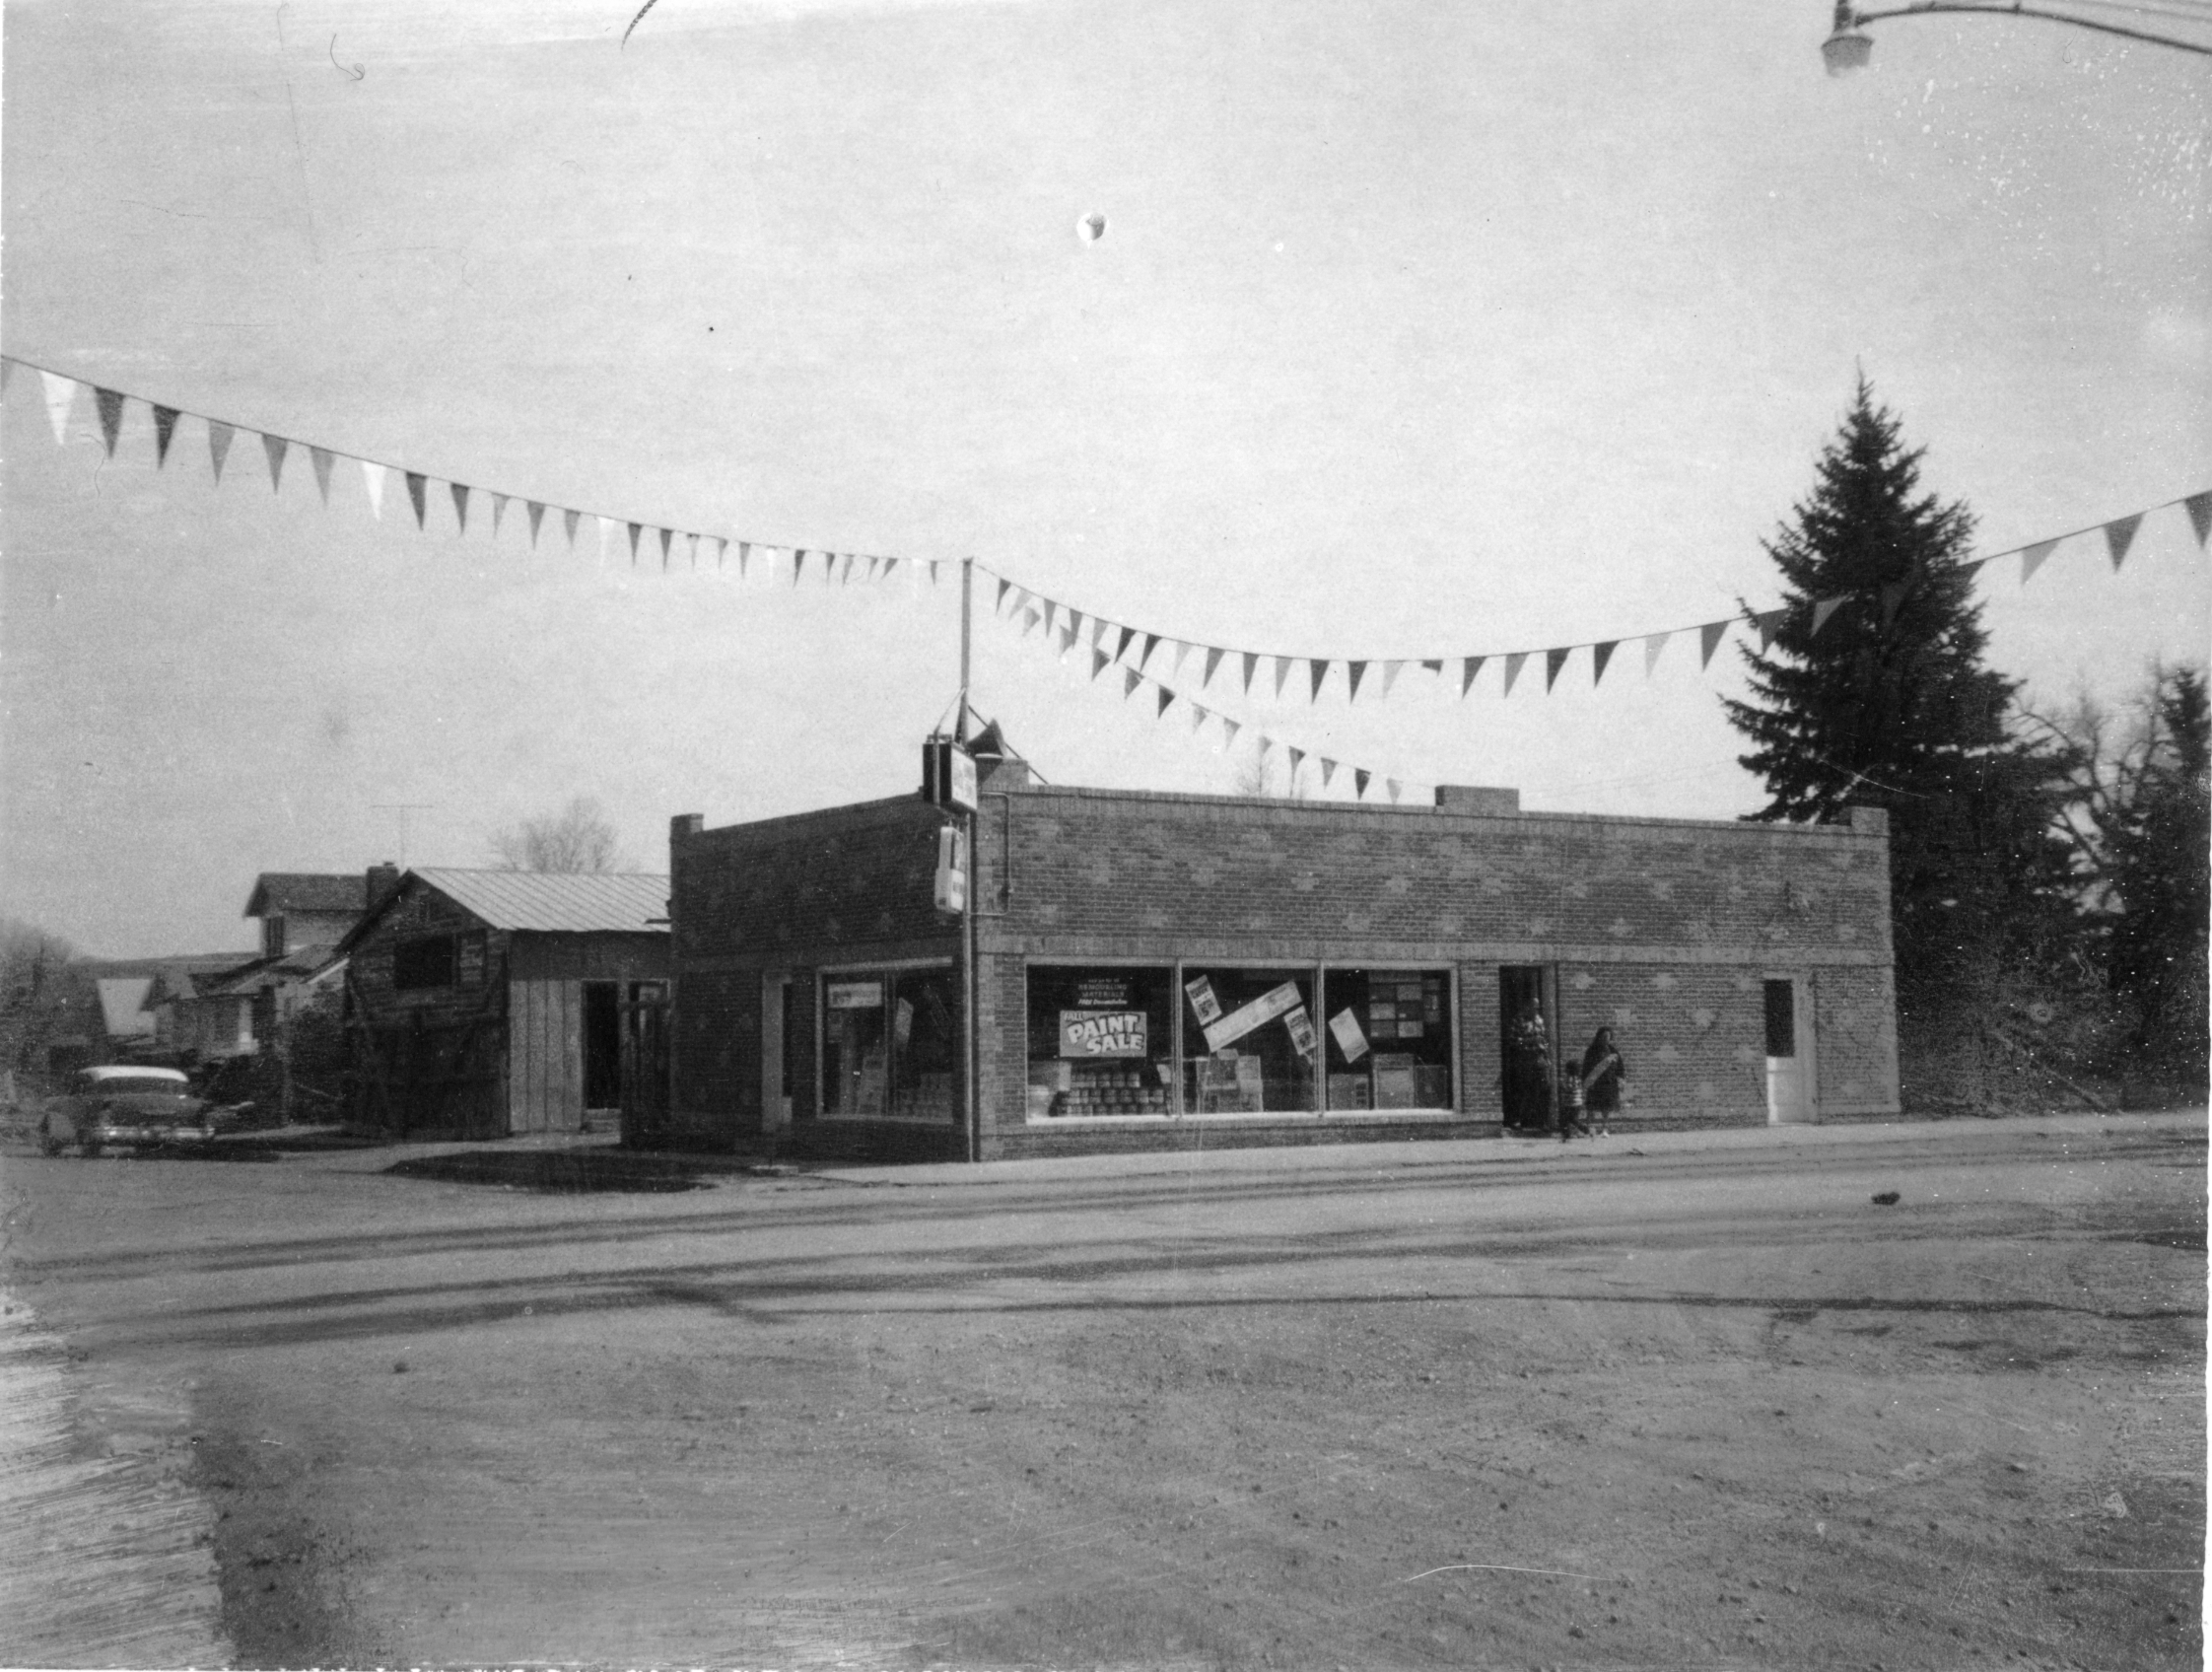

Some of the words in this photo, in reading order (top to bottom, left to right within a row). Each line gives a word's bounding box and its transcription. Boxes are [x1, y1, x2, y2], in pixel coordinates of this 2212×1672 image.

[1064, 1011, 1084, 1021] FALL
[1067, 1013, 1140, 1044] PAINT
[1086, 1032, 1143, 1054] SALE
